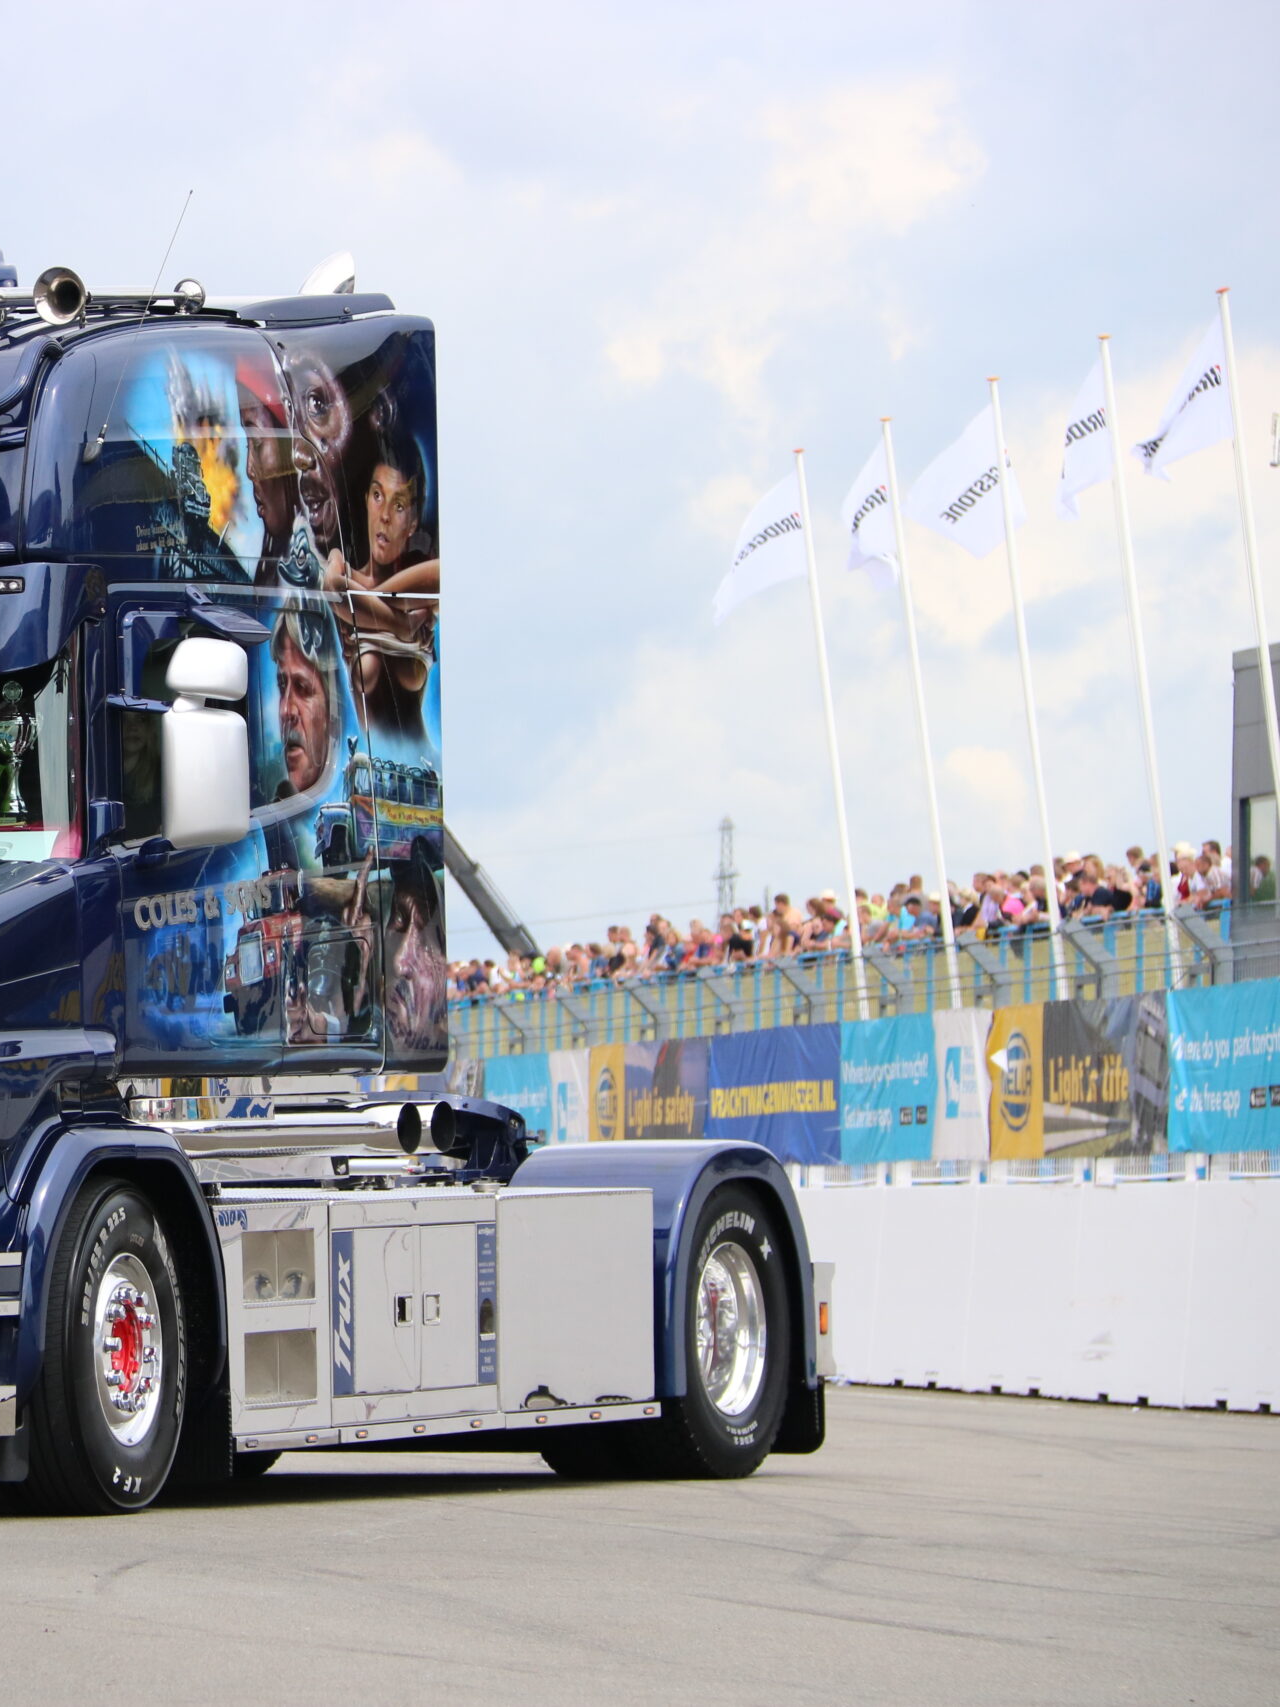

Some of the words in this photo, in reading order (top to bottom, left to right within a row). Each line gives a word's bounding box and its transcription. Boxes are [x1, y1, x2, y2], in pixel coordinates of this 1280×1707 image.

[134, 889, 197, 931] COLES
[204, 886, 220, 920] &
[224, 877, 272, 915] SONS
